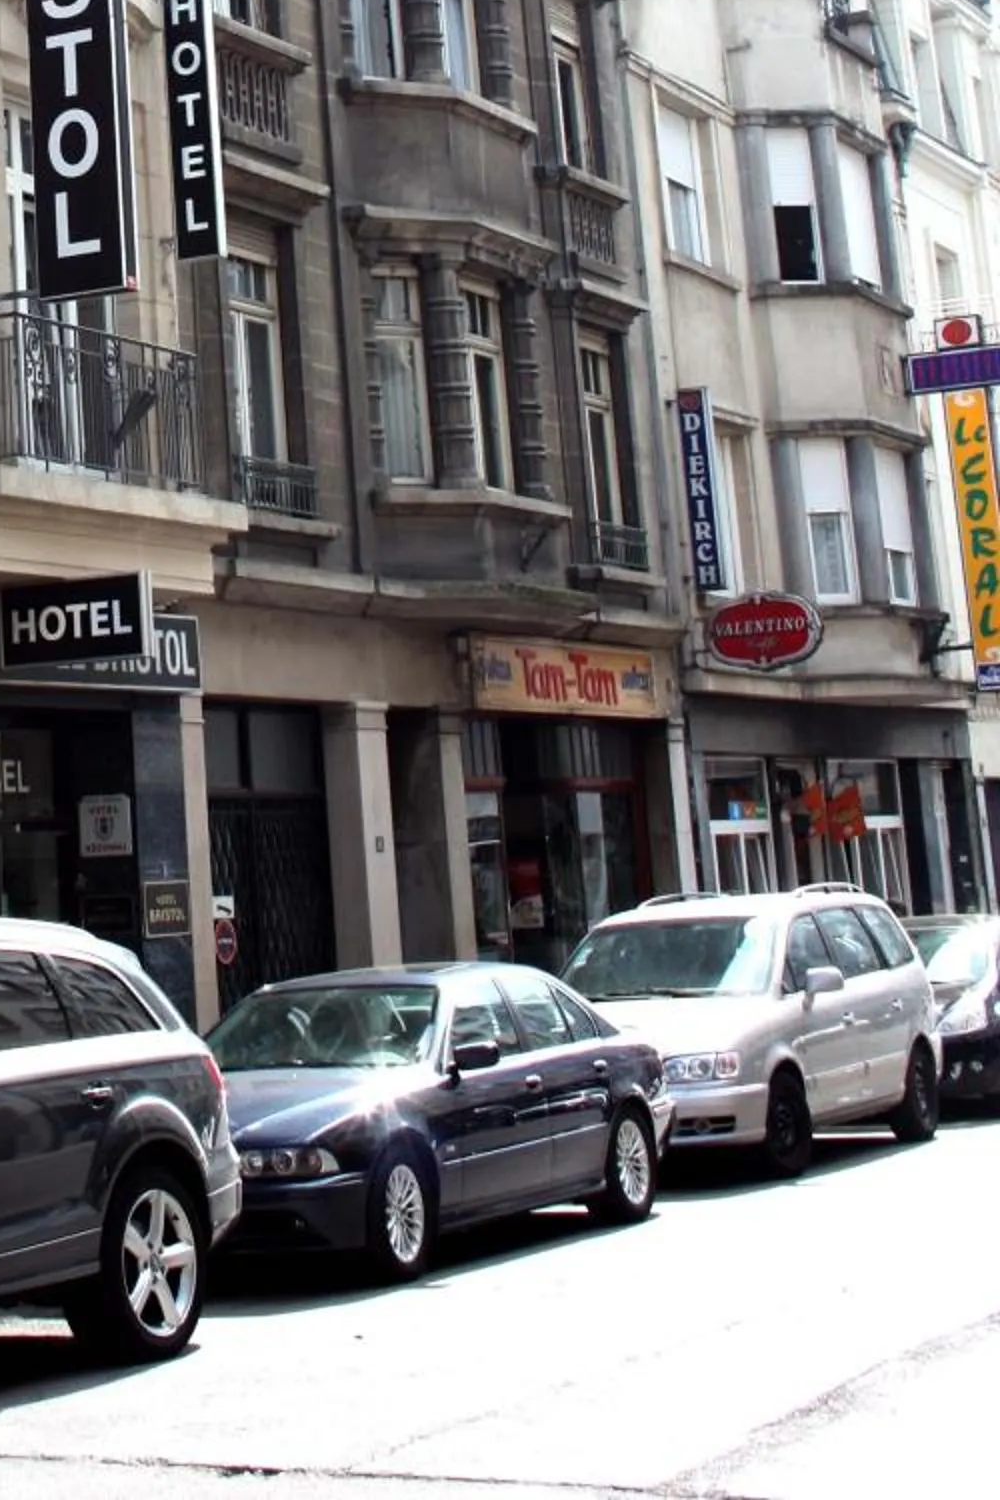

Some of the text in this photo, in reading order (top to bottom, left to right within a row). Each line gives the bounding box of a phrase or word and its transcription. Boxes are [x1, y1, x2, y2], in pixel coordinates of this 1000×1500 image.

[683, 414, 718, 587] DIEKIRCH
[960, 452, 1000, 638] CORAL
[11, 599, 133, 645] HOTEL
[714, 615, 806, 637] VALENTINO
[514, 648, 619, 707] Tam-Tam
